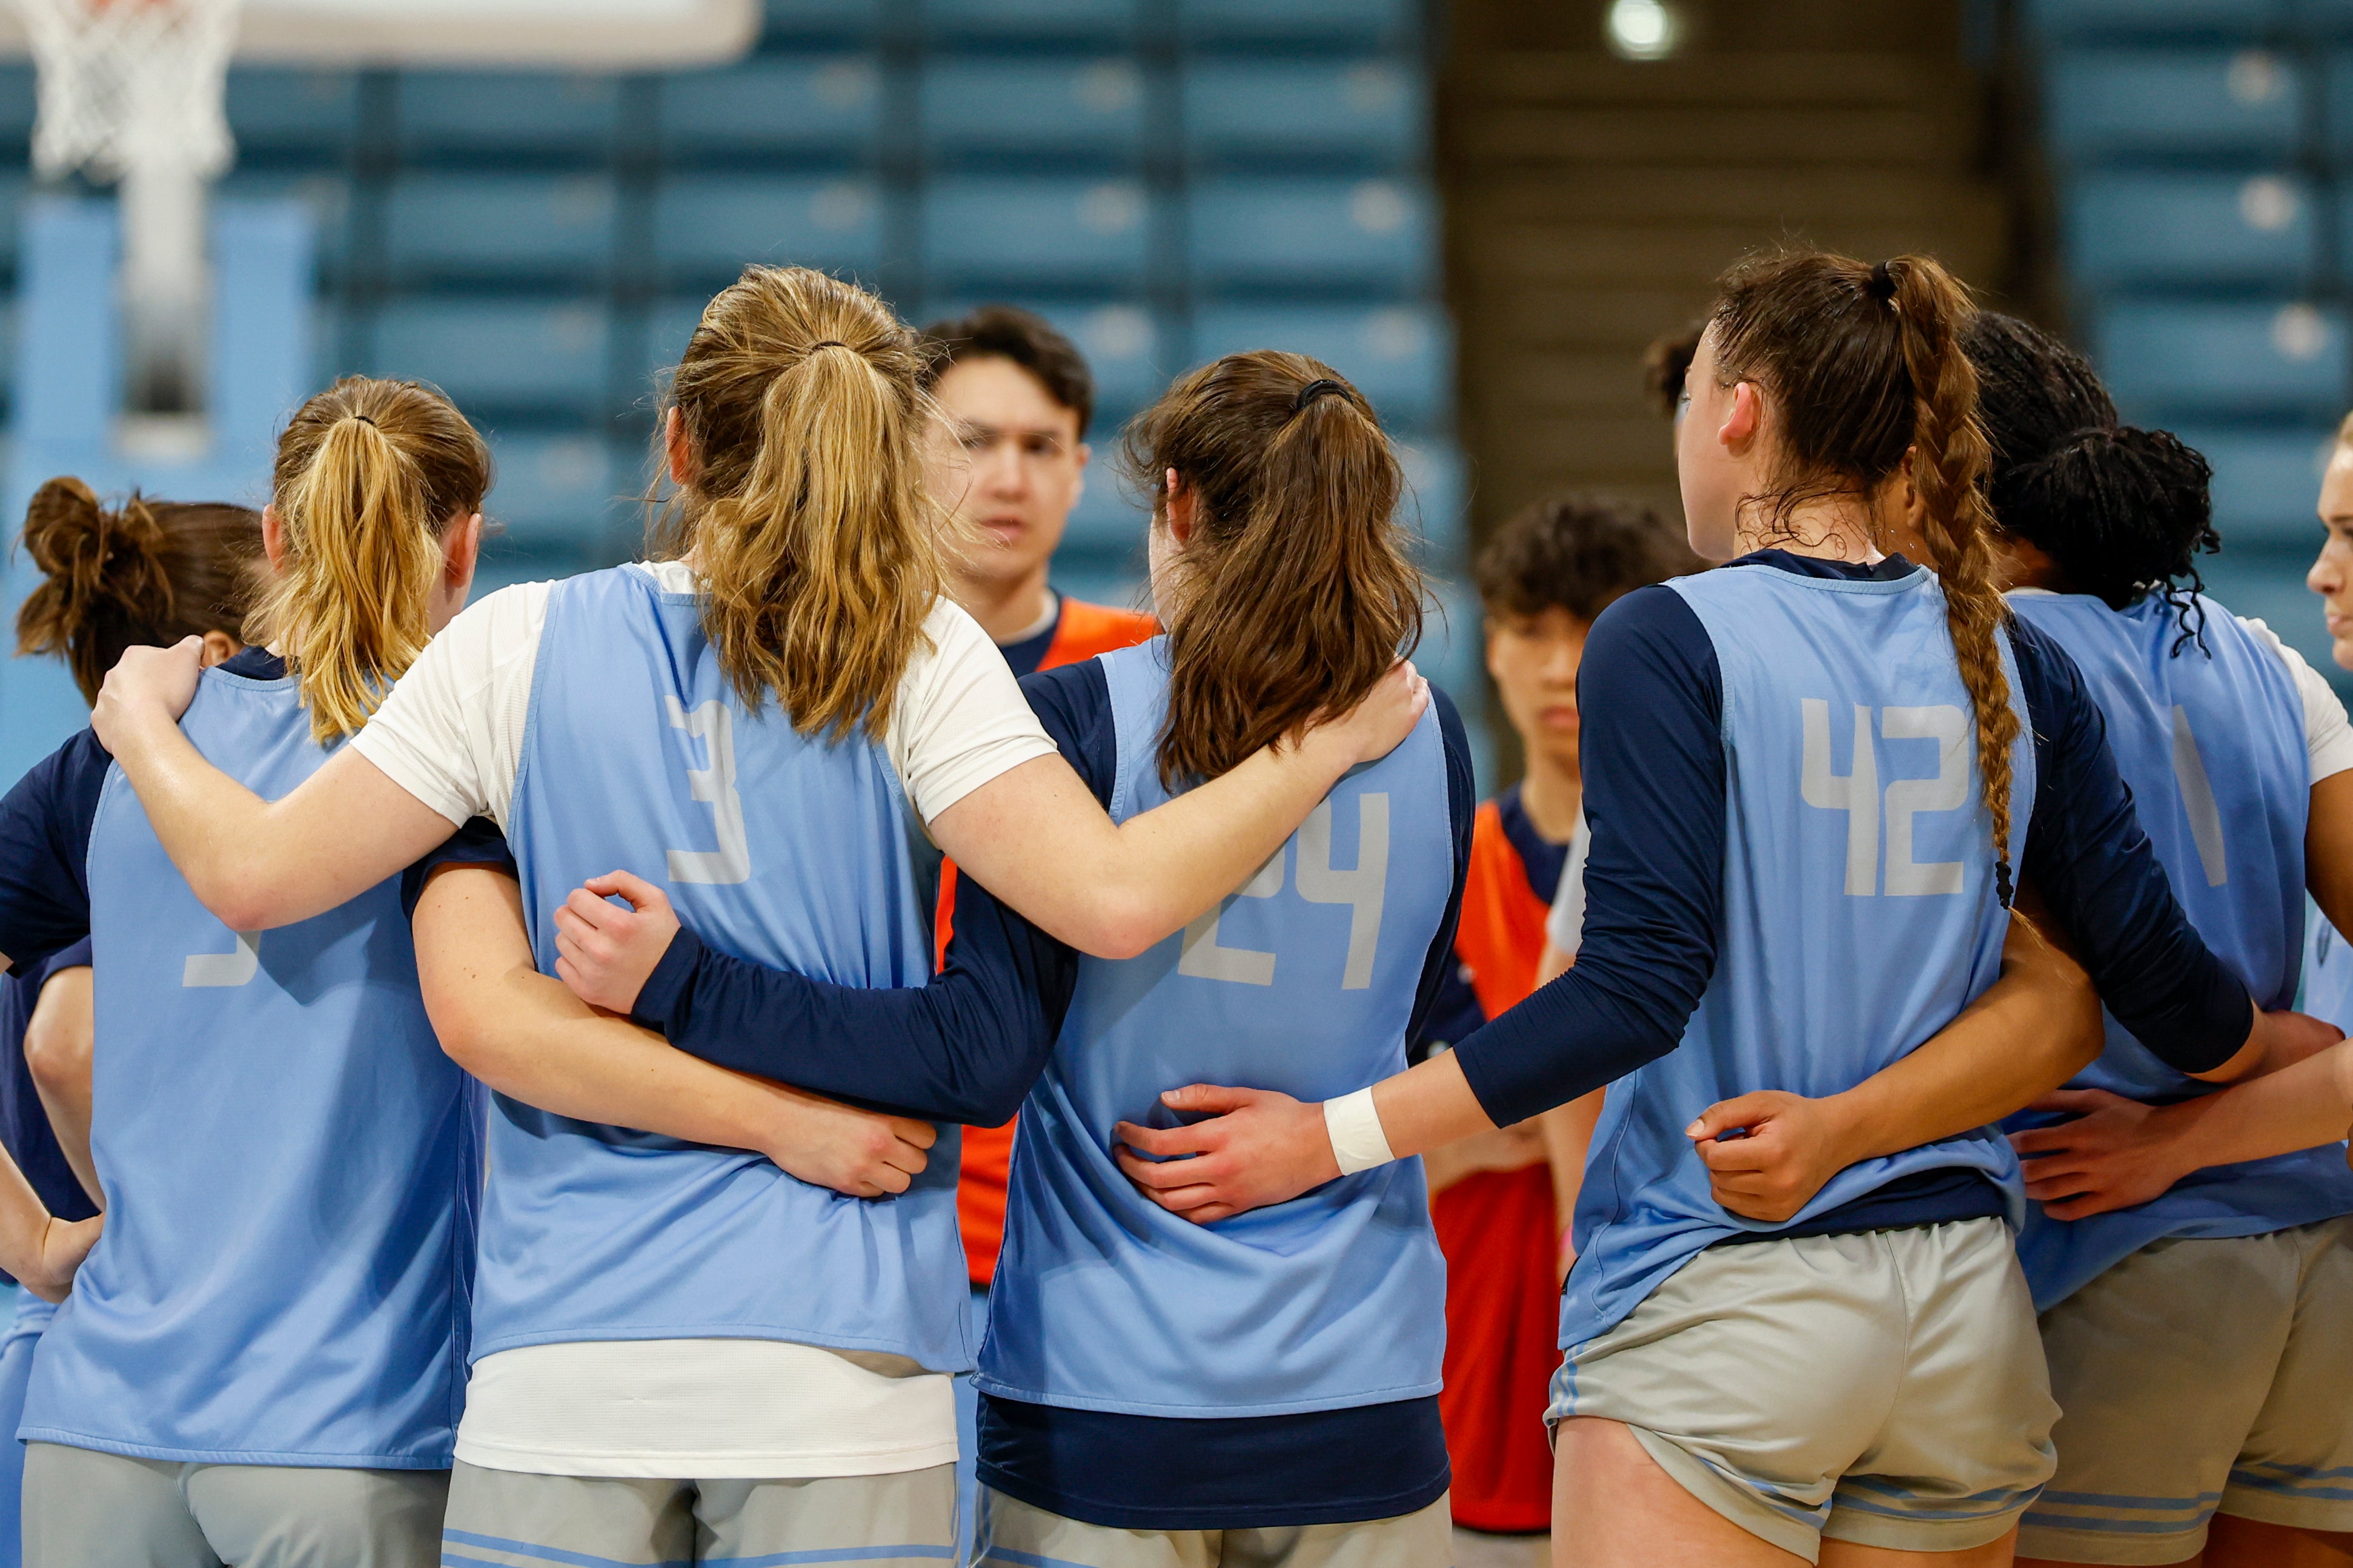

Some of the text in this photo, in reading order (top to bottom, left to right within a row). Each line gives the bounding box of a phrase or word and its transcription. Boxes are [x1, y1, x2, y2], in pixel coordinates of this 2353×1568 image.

[665, 695, 751, 884] 3
[1800, 698, 1970, 896] 42
[2172, 704, 2227, 887] 1
